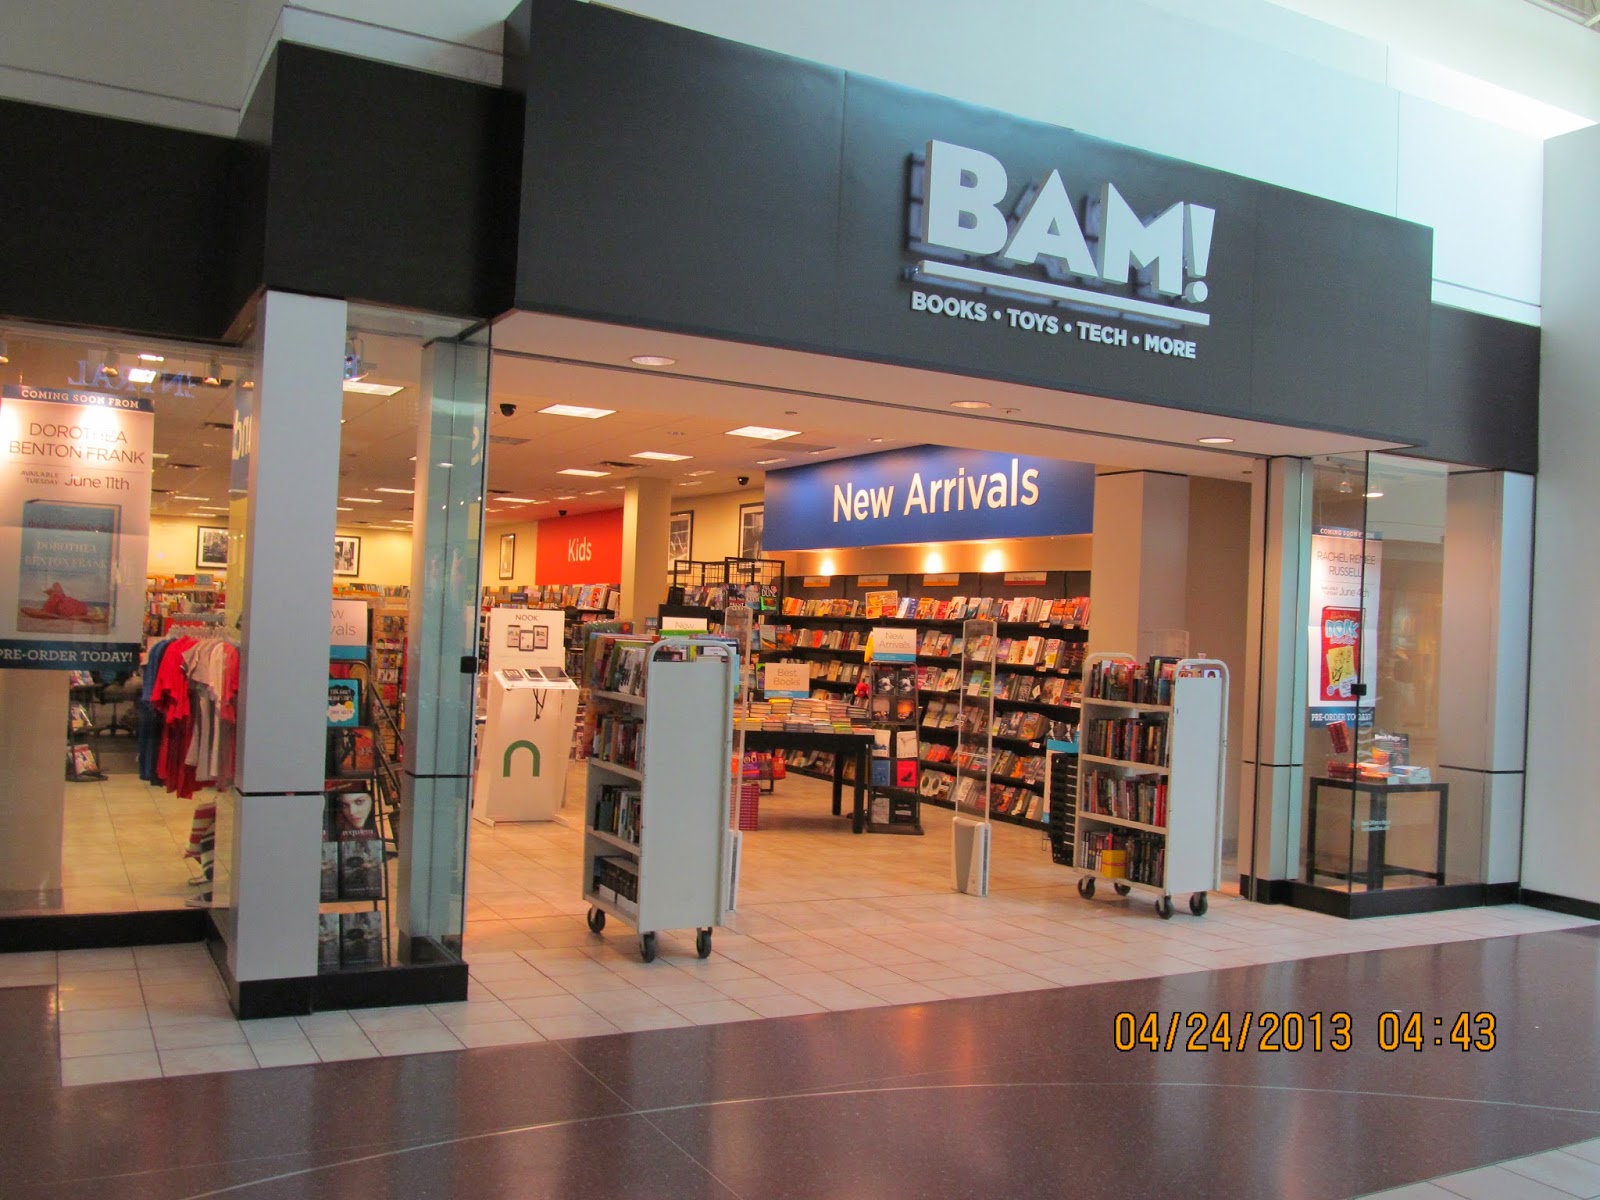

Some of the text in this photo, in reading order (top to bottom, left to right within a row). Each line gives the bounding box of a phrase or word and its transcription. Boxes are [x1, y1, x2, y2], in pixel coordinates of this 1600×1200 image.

[922, 139, 1215, 303] BAM!
[911, 290, 1196, 359] BOOKS TOYS TECH MORE
[22, 389, 139, 409] COMING SOON FROM
[9, 440, 145, 464] BENTON FRANK
[21, 470, 130, 490] AVAILABLE June 11th
[26, 478, 59, 486] TUESDAY
[832, 457, 1040, 523] New Arrivals
[567, 536, 592, 562] Kids
[1316, 550, 1348, 563] RACHEL
[1328, 565, 1362, 578] RUSSELL
[1339, 587, 1355, 597] June
[515, 614, 539, 622] NOOK
[675, 621, 694, 630] New
[1325, 618, 1359, 639] DORK
[885, 632, 905, 640] New
[879, 640, 911, 649] Arrivals
[81, 651, 133, 663] TODAY!
[777, 668, 799, 677] Best
[773, 677, 801, 686] Books
[1311, 713, 1345, 721] PRE-ORDER
